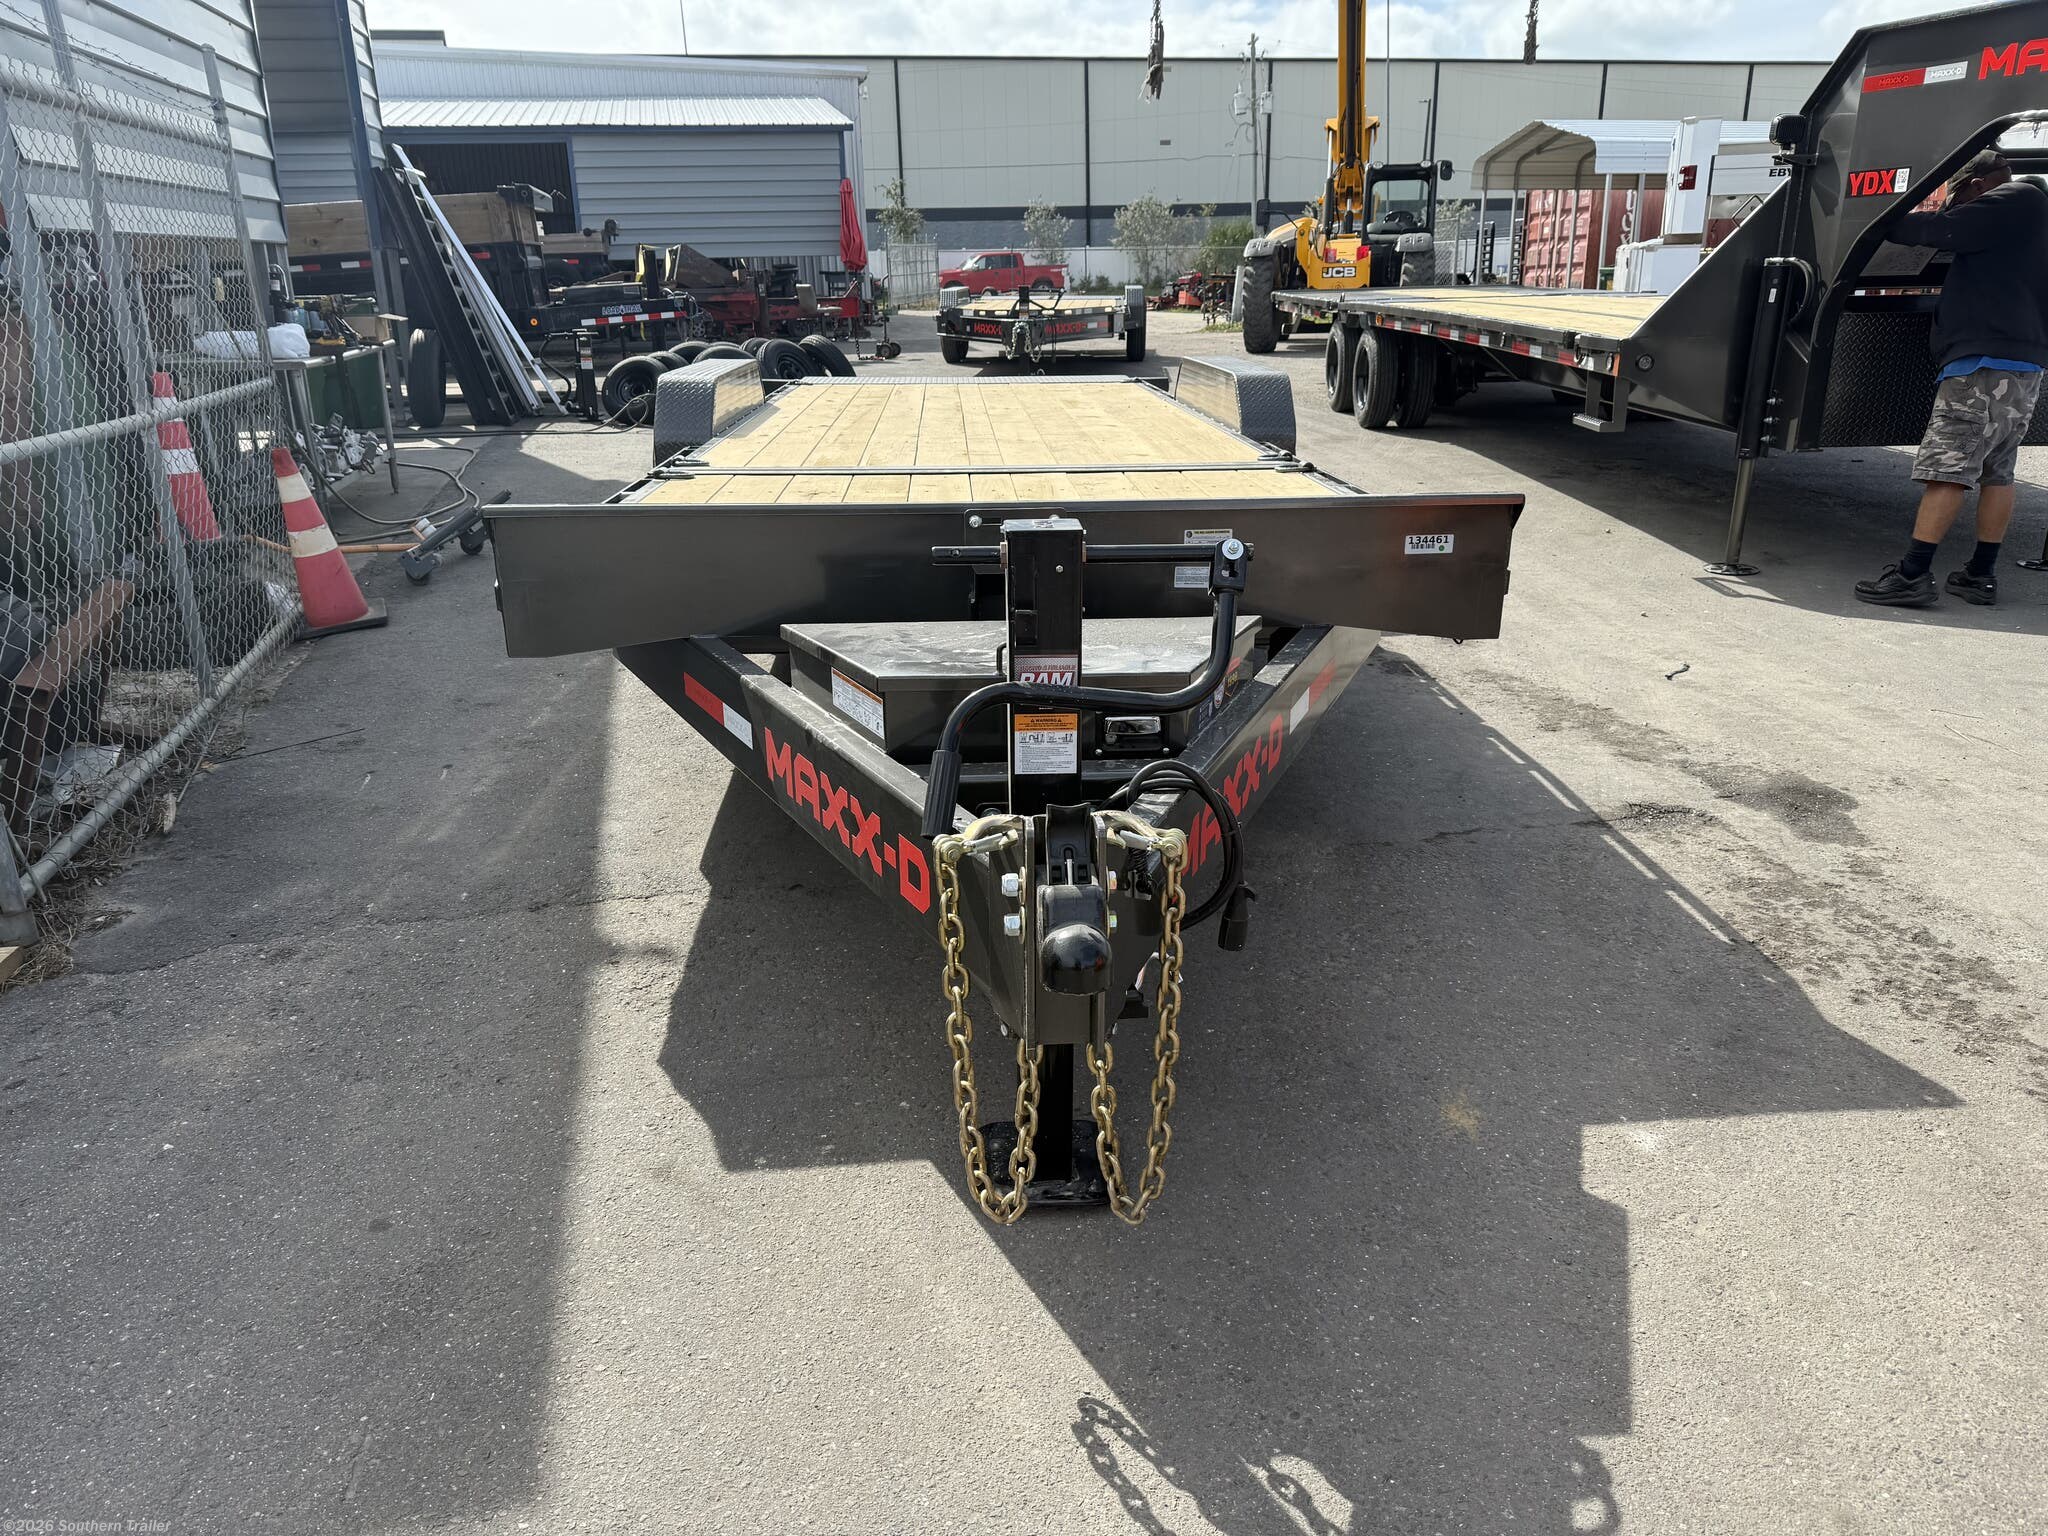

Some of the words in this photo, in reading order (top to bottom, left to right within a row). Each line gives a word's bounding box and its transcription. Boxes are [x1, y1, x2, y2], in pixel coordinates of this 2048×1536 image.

[1929, 67, 1962, 79] MAXX-D
[1849, 169, 1896, 197] YDX
[1322, 267, 1356, 278] JCB
[1408, 535, 1449, 545] 134461
[764, 727, 931, 914] MAXX-D
